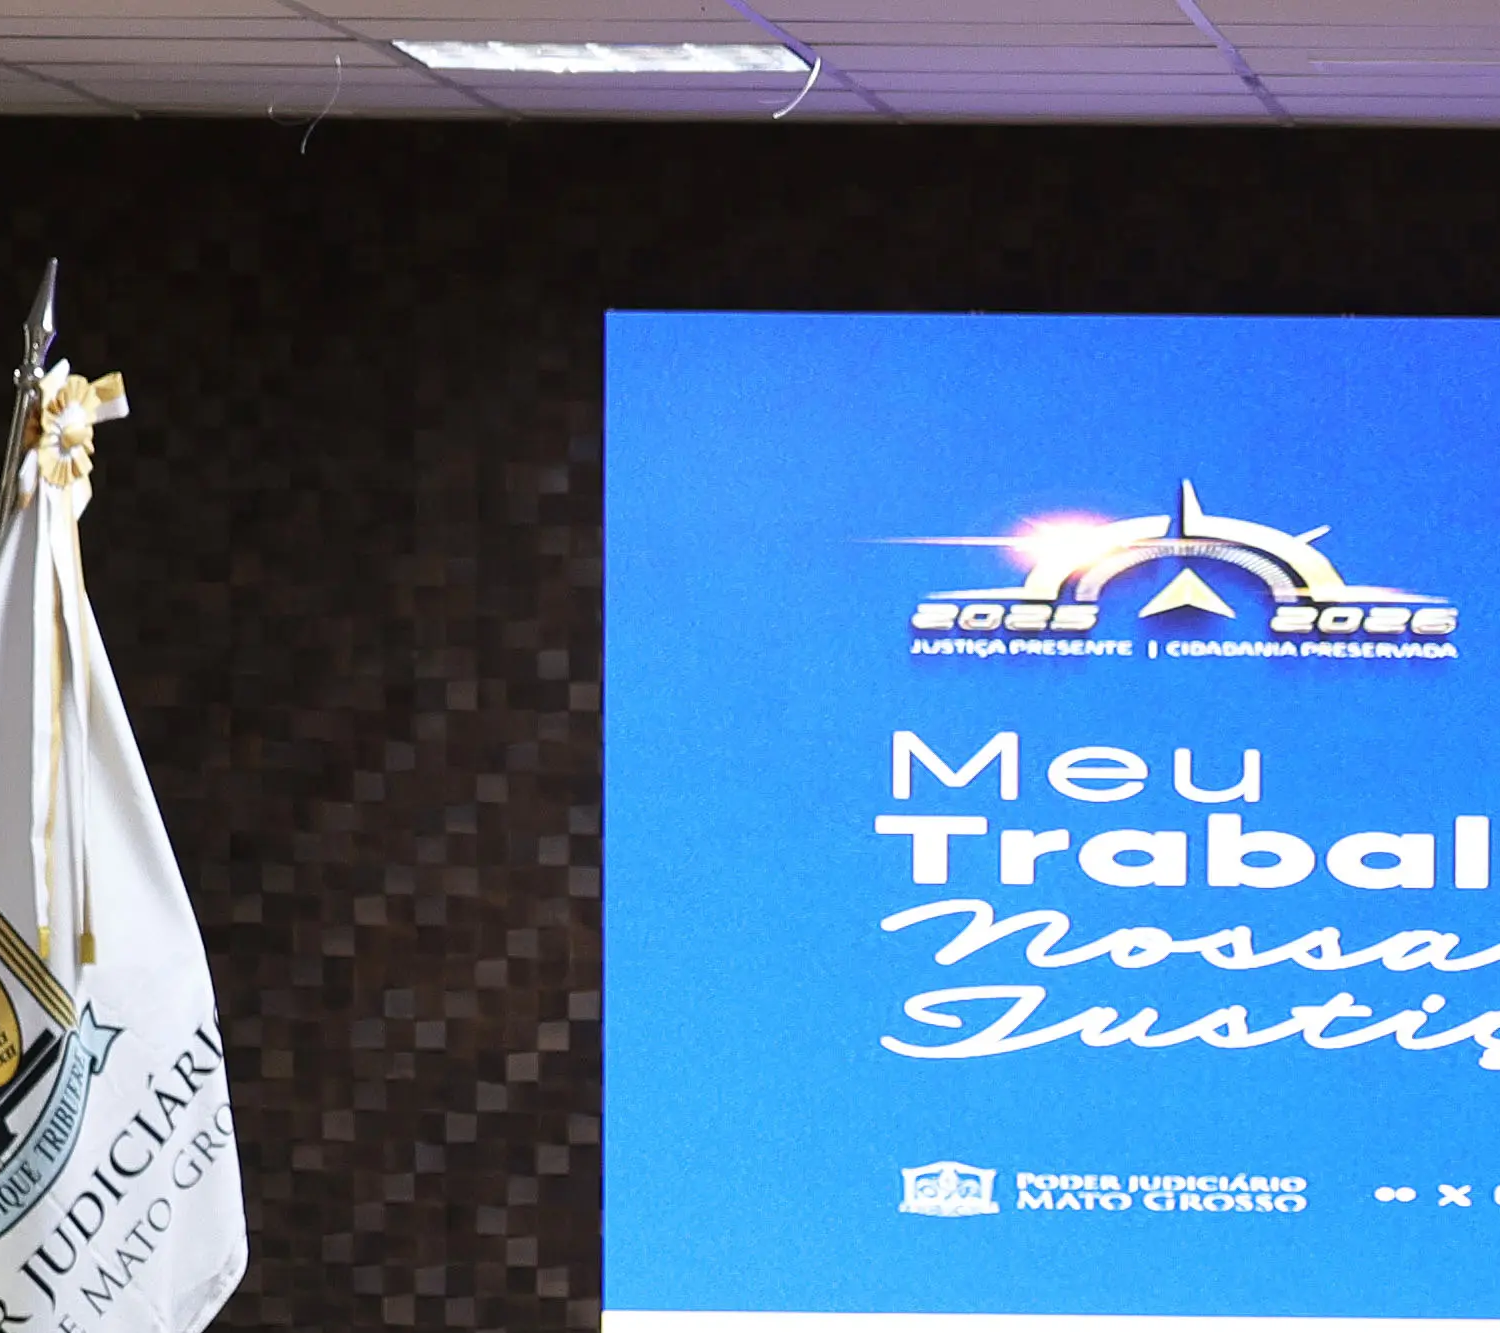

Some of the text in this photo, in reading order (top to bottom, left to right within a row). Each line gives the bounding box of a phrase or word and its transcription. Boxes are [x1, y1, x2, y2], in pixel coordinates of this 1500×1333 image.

[911, 602, 1100, 631] 2025
[1269, 604, 1459, 635] 2026
[910, 638, 1007, 659] JUSTIÇA
[1009, 639, 1133, 657] PRESENTE
[1166, 640, 1298, 658] CIDADANIA
[1300, 641, 1459, 659] PRESERVADA
[892, 730, 1261, 804] Meu
[19, 1008, 223, 1313] JUDICIÁRI
[1016, 1172, 1307, 1193] PODER JUDICIÁRIO
[1016, 1191, 1307, 1213] MATO GROSSO
[79, 1197, 173, 1319] MATO
